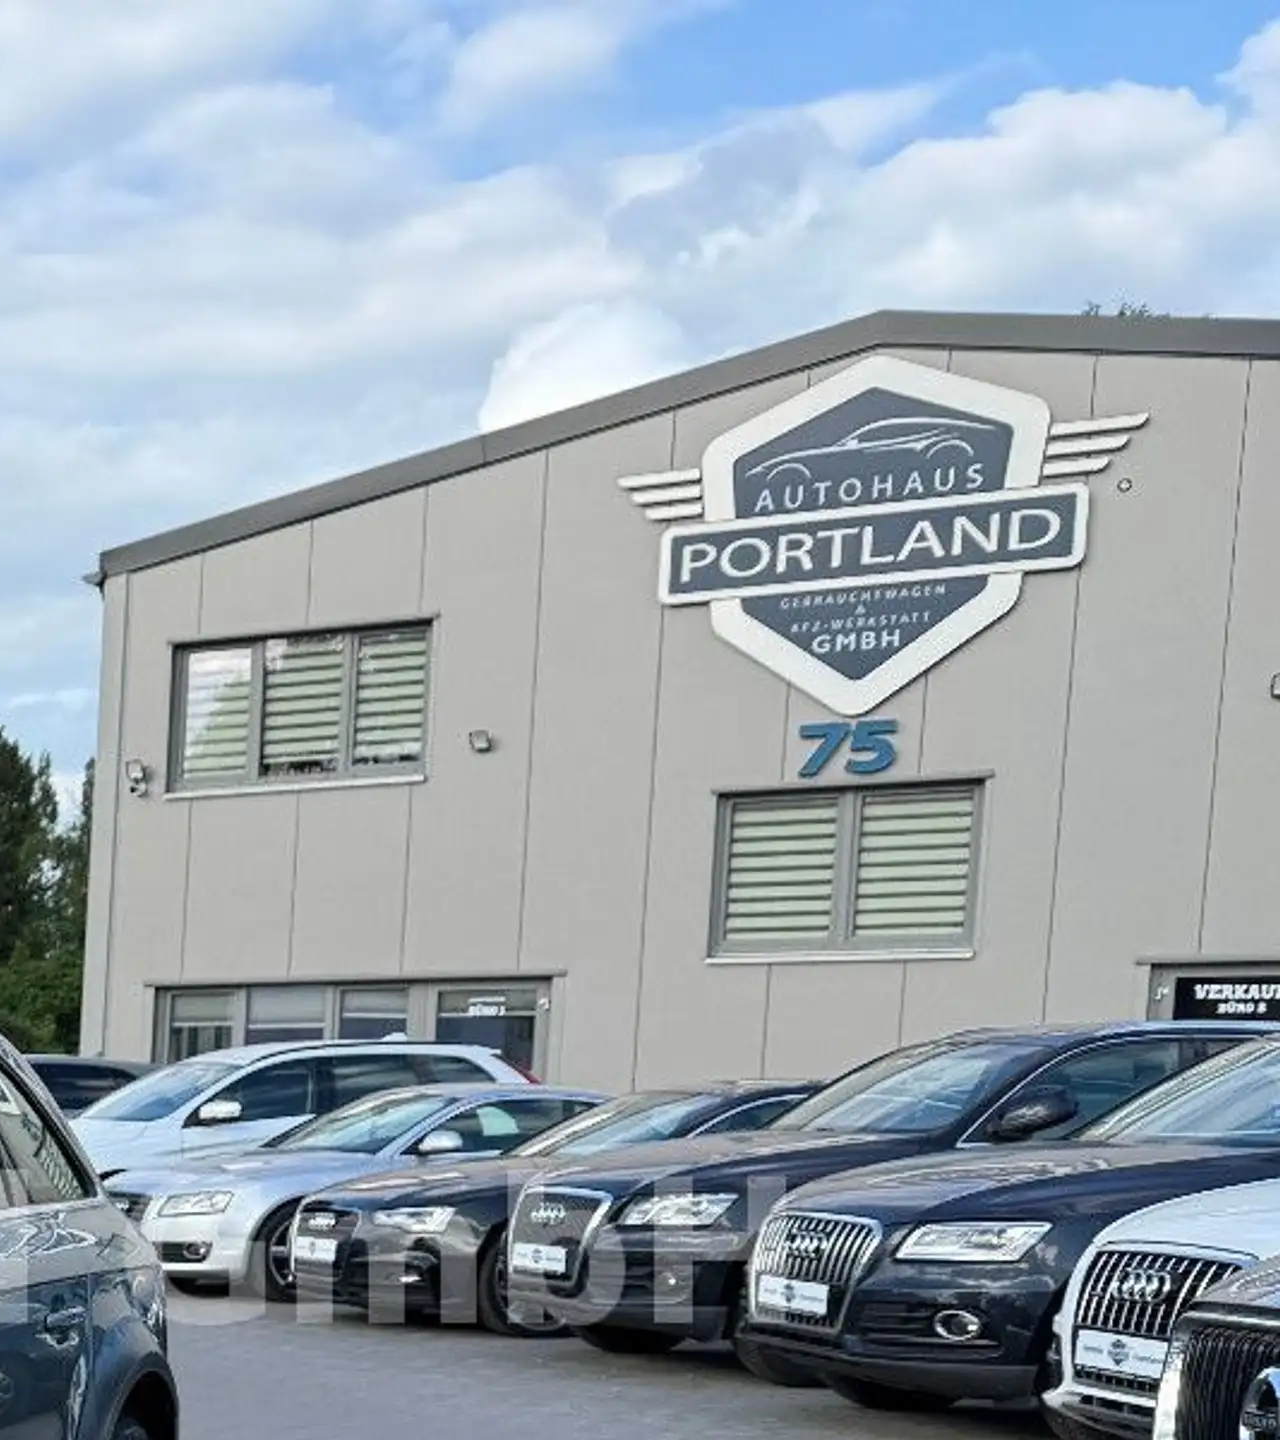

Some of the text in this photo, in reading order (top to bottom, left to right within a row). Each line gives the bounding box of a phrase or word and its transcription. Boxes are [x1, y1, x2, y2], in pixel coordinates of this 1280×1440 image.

[754, 462, 984, 513] AUTOHAUS
[679, 507, 1061, 584] PORTLAND
[811, 628, 901, 654] GMBH
[798, 717, 899, 779] 75
